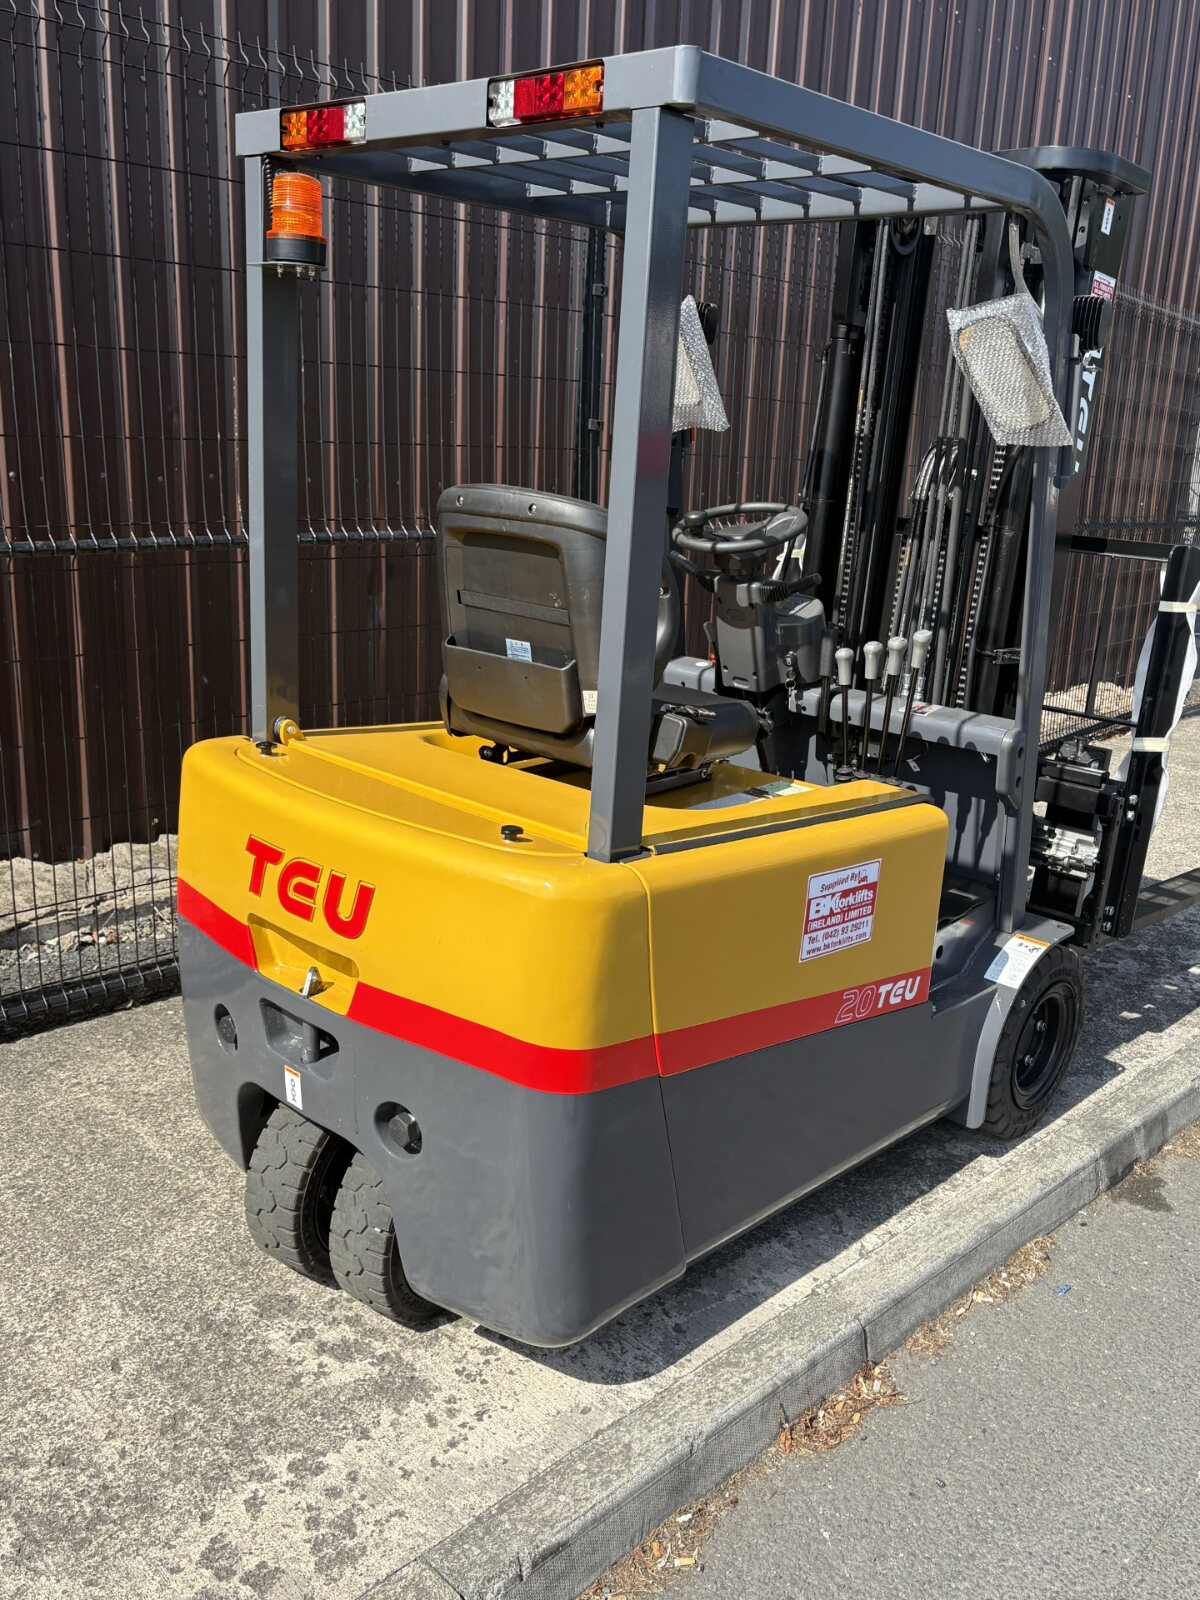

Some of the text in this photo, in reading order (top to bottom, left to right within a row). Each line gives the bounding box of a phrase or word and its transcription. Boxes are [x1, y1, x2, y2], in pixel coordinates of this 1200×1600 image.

[245, 834, 376, 940] TEU
[820, 875, 850, 892] Supplied
[807, 906, 872, 933] (IRELAND) LIMITED
[808, 919, 869, 945] Tel. (042) 93 29211
[806, 932, 868, 956] www.bkforklifts.com
[834, 976, 921, 1024] 20 TEU
